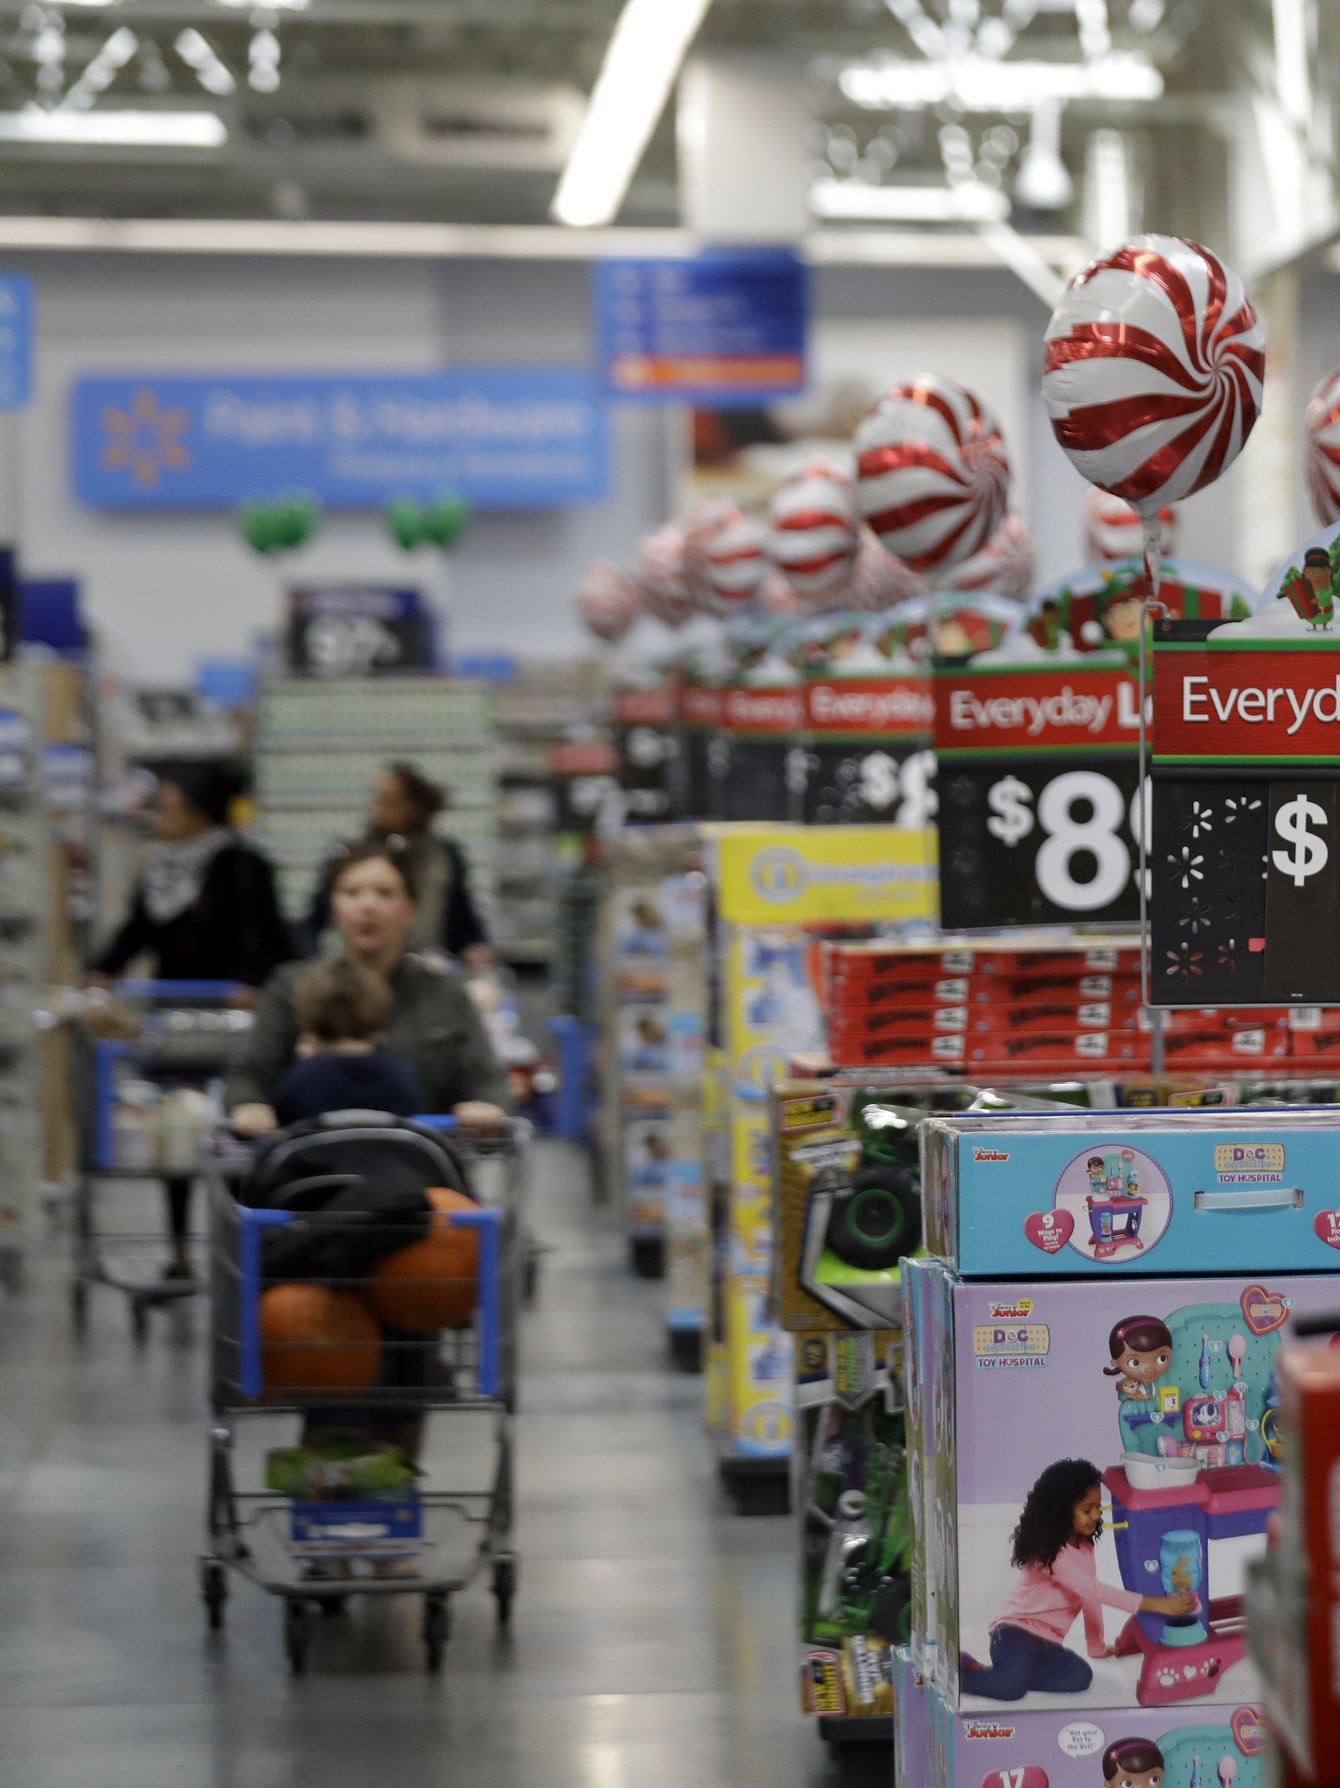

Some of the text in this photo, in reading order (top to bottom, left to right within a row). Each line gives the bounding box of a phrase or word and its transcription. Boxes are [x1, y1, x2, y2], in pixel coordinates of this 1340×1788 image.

[949, 685, 1113, 736] Everyday
[986, 770, 1153, 912] $8
[1219, 1174, 1235, 1183] TOY
[1042, 1213, 1055, 1229] 9
[978, 1359, 996, 1367] TOY
[998, 1767, 1026, 1788] 17
